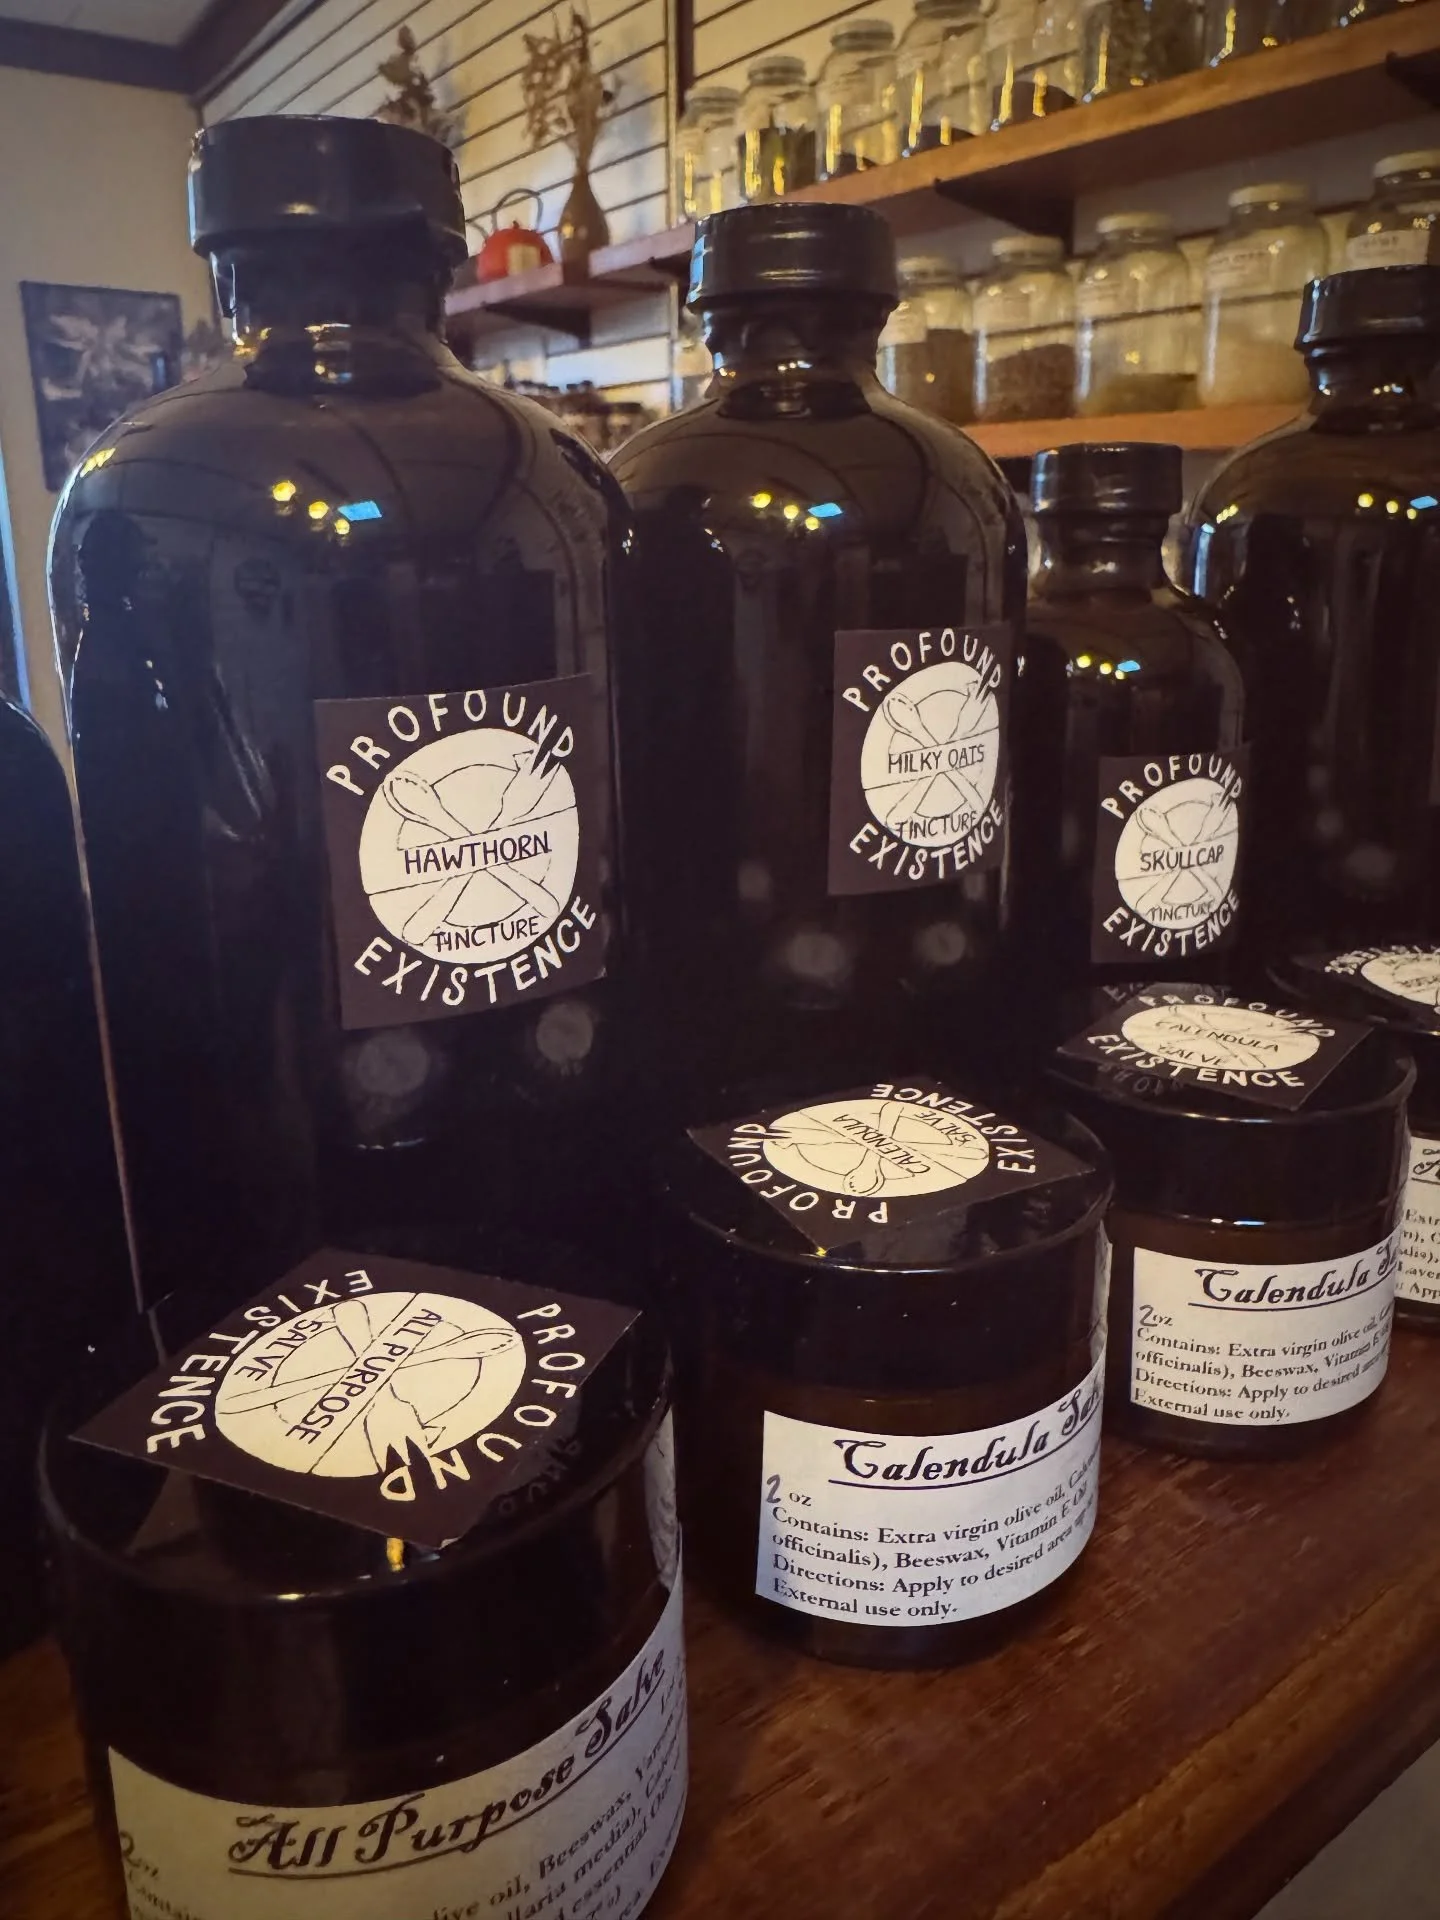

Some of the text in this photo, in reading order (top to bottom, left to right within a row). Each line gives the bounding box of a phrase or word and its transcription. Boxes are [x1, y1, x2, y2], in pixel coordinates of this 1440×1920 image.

[843, 628, 1002, 711] PROFOUND
[326, 689, 574, 796] PROFOUND
[948, 744, 985, 769] OATS
[1101, 753, 1243, 819] PROFOUND
[404, 831, 551, 874] HAWTHORN
[849, 799, 1004, 880] EXISTENCE
[1140, 845, 1225, 872] SKULLCAP
[354, 896, 597, 1006] EXISTENCE
[434, 916, 541, 953] TINCTURE
[1101, 888, 1240, 957] EXISTENCE
[1087, 1034, 1305, 1087] EXISTENCE
[832, 1114, 931, 1175] CALENDULA
[870, 1083, 1037, 1174] EXISTENCE
[914, 1110, 977, 1147] SALVE
[727, 1122, 888, 1224] PROFOUND
[1194, 1259, 1370, 1304] Calendula
[146, 1269, 373, 1453] EXISTENCE
[234, 1318, 321, 1381] SALVE
[1135, 1350, 1236, 1379] officinalis),
[1136, 1327, 1222, 1355] Contains:
[1229, 1342, 1276, 1358] Extra
[1282, 1338, 1327, 1359] virgin
[284, 1308, 444, 1445] ALL PURPOSE
[380, 1303, 587, 1502] PROFOUND
[1134, 1387, 1291, 1422] External use only.
[1135, 1367, 1232, 1398] Directions:
[1238, 1385, 1289, 1404] Apply
[1294, 1384, 1309, 1396] to
[832, 1420, 1048, 1482] Calendula
[771, 1506, 871, 1542] Contains:
[877, 1526, 937, 1545] Extra
[942, 1517, 999, 1541] virgin
[1003, 1502, 1042, 1527] olive
[788, 1490, 812, 1508] oz
[771, 1533, 889, 1572] officinalis),
[893, 1545, 991, 1572] Beeswax,
[995, 1515, 1058, 1552] Vitamin
[772, 1553, 885, 1592] Directions:
[891, 1576, 954, 1598] Apply
[960, 1574, 979, 1587] to
[984, 1545, 1044, 1581] desired
[772, 1577, 958, 1621] External use only.
[227, 1813, 346, 1871] All
[353, 1753, 577, 1863] Purpose
[574, 1649, 665, 1759] Salve
[489, 1874, 531, 1906] oil,
[539, 1791, 632, 1880] Beeswax,
